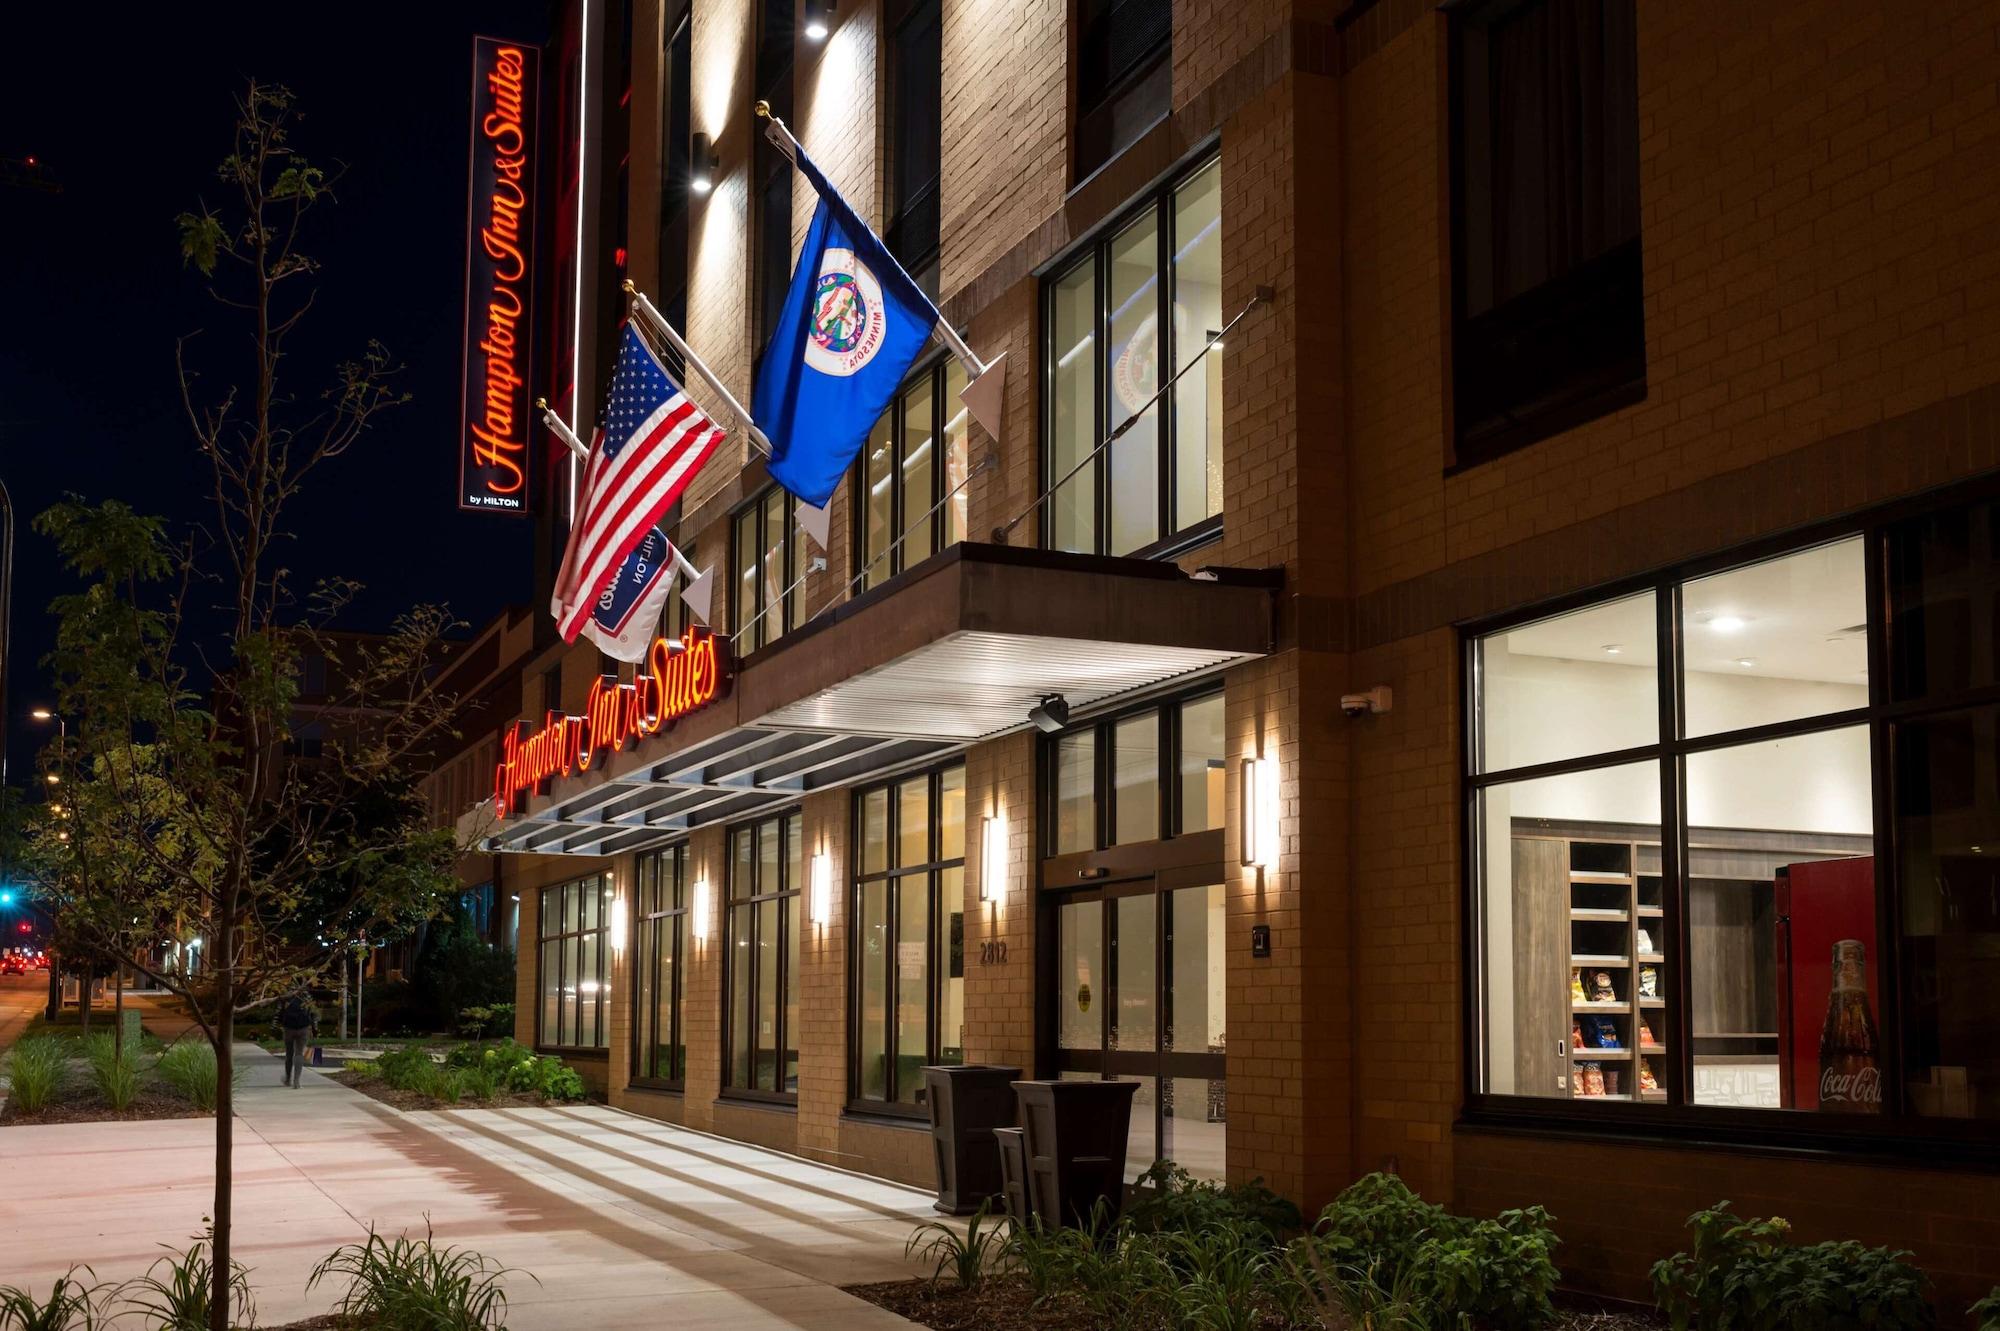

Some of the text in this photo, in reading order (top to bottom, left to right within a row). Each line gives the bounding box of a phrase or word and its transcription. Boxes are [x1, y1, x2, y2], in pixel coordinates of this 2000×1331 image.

[472, 48, 526, 494] Hampton Inn & Suites
[469, 495, 519, 508] by HILTON
[495, 711, 577, 820] Hampton
[577, 674, 630, 771] Inn
[643, 625, 717, 734] Suites
[979, 942, 1008, 965] 2812
